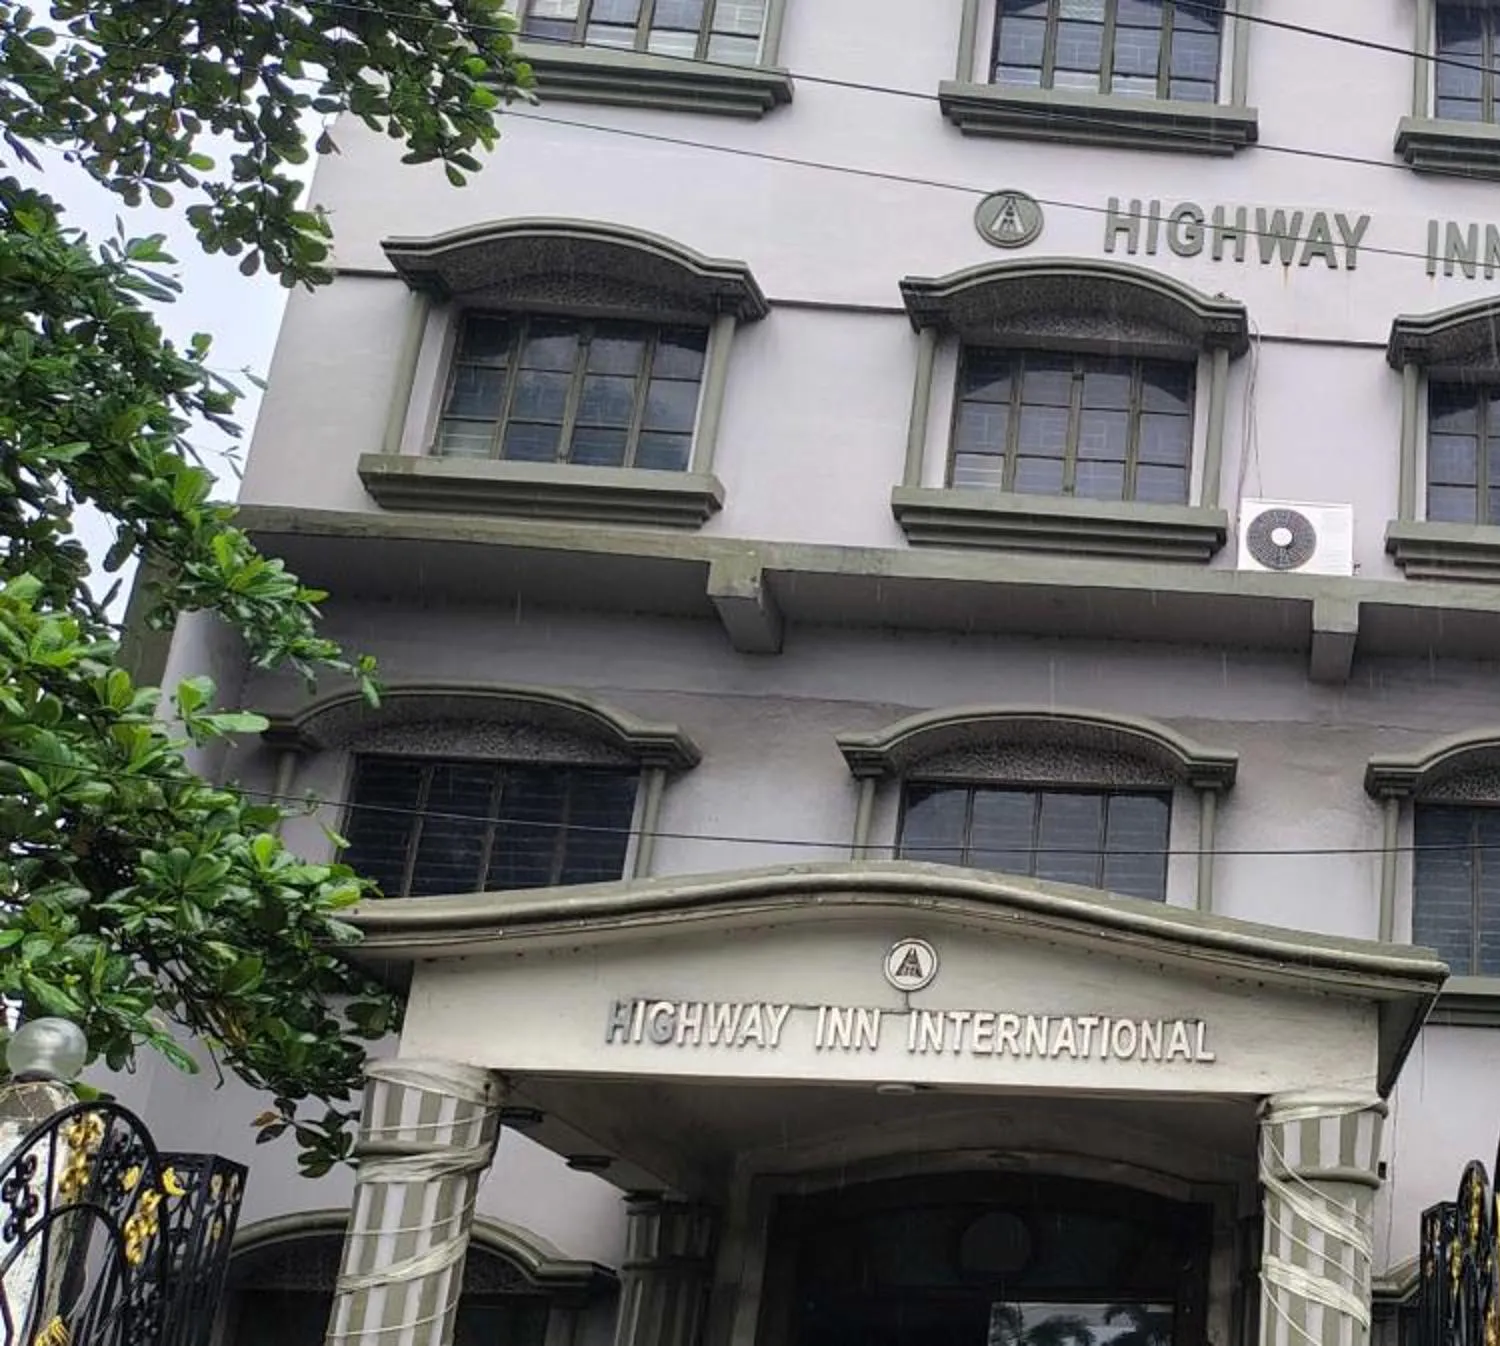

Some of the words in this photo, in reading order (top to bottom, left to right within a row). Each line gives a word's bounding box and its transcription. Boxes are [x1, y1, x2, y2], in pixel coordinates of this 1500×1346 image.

[1103, 197, 1371, 270] HIGHWAY
[605, 1001, 788, 1047] HIGHWAY
[815, 1006, 881, 1049] INN
[907, 1010, 1216, 1062] INTERNATIONAL
